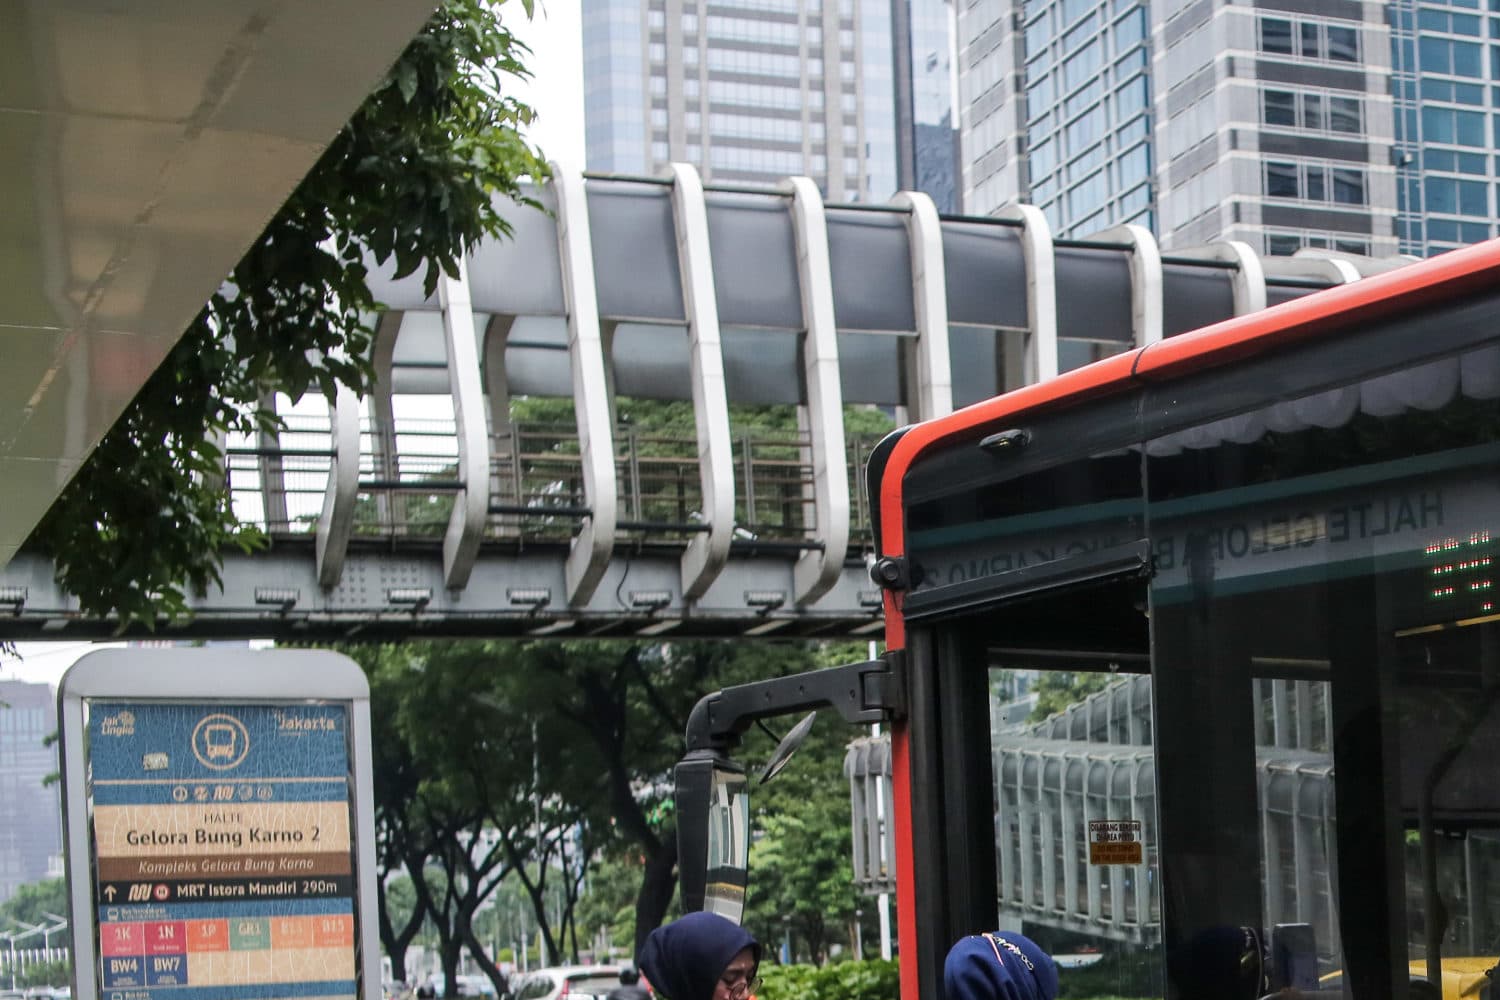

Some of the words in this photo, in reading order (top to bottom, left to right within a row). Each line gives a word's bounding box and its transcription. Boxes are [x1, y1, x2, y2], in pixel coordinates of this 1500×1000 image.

[203, 812, 243, 825] HALTE
[126, 829, 188, 846] Gelora
[195, 828, 243, 847] Bung
[249, 827, 304, 844] Karno
[311, 826, 321, 842] 2
[139, 860, 197, 877] Kompleks
[199, 857, 241, 874] Gelora
[245, 857, 275, 873] Bung
[279, 856, 314, 870] Karno
[177, 884, 205, 897] MRT
[209, 883, 245, 896] Istora
[249, 882, 297, 896] Mandiri
[303, 881, 338, 894] 290m
[115, 926, 131, 940] 1K
[158, 925, 174, 939] 1N
[111, 959, 138, 973] BW4
[154, 957, 181, 972] BW7
